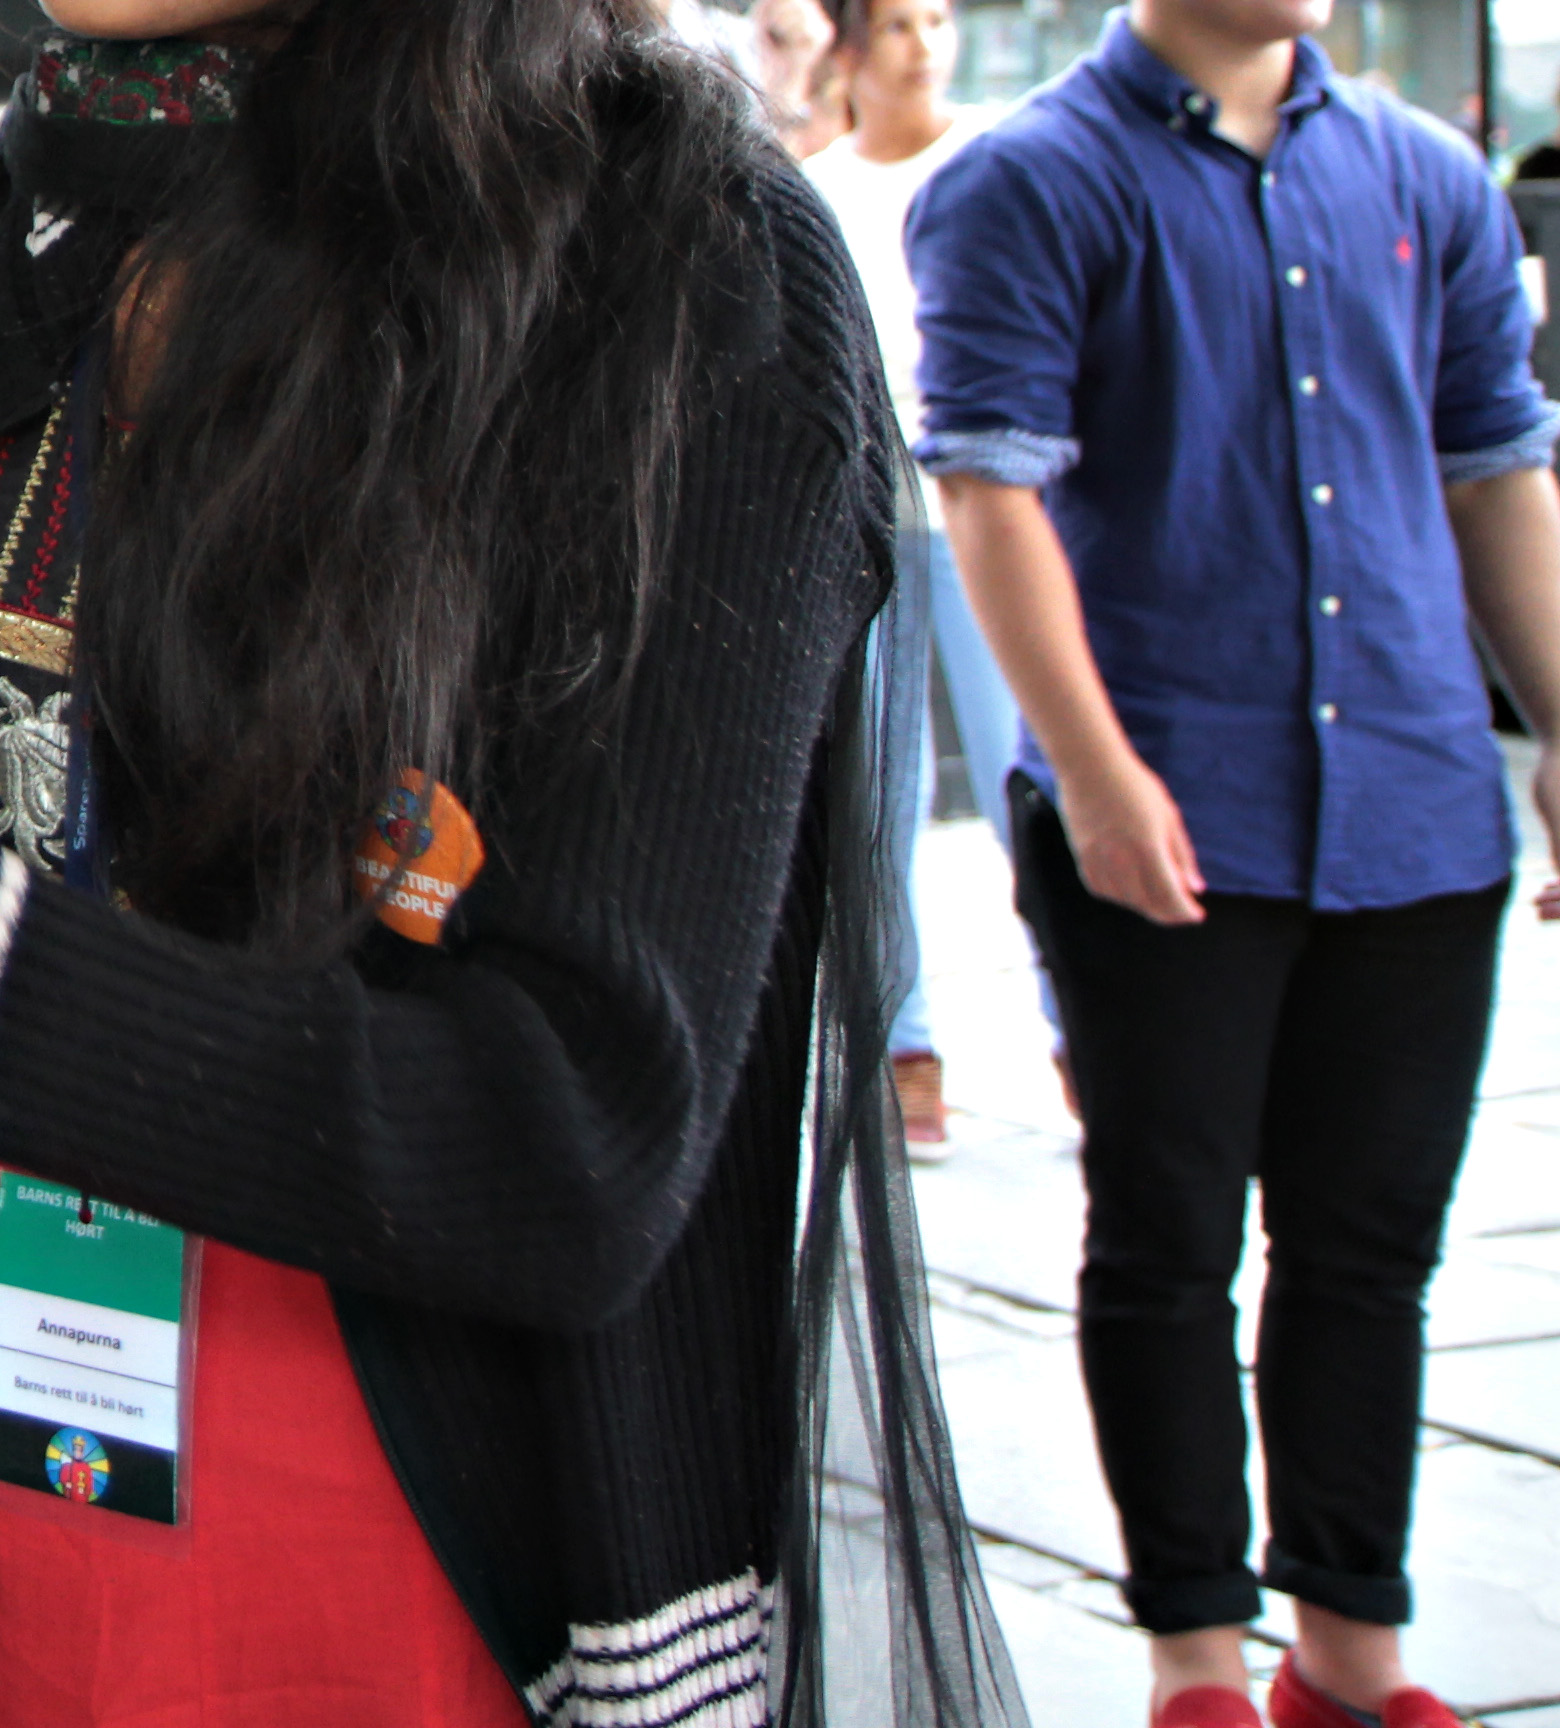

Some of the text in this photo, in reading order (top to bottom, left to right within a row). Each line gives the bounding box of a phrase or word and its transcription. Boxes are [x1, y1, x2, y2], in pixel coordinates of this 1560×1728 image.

[355, 855, 457, 901] BEATIFU
[17, 1185, 63, 1207] BARNS
[65, 1195, 98, 1216] RET
[101, 1202, 121, 1220] TIL
[65, 1219, 105, 1240] HØRT
[37, 1318, 122, 1350] Annapurna
[14, 1375, 144, 1418] Barns rett til å bli hørt
